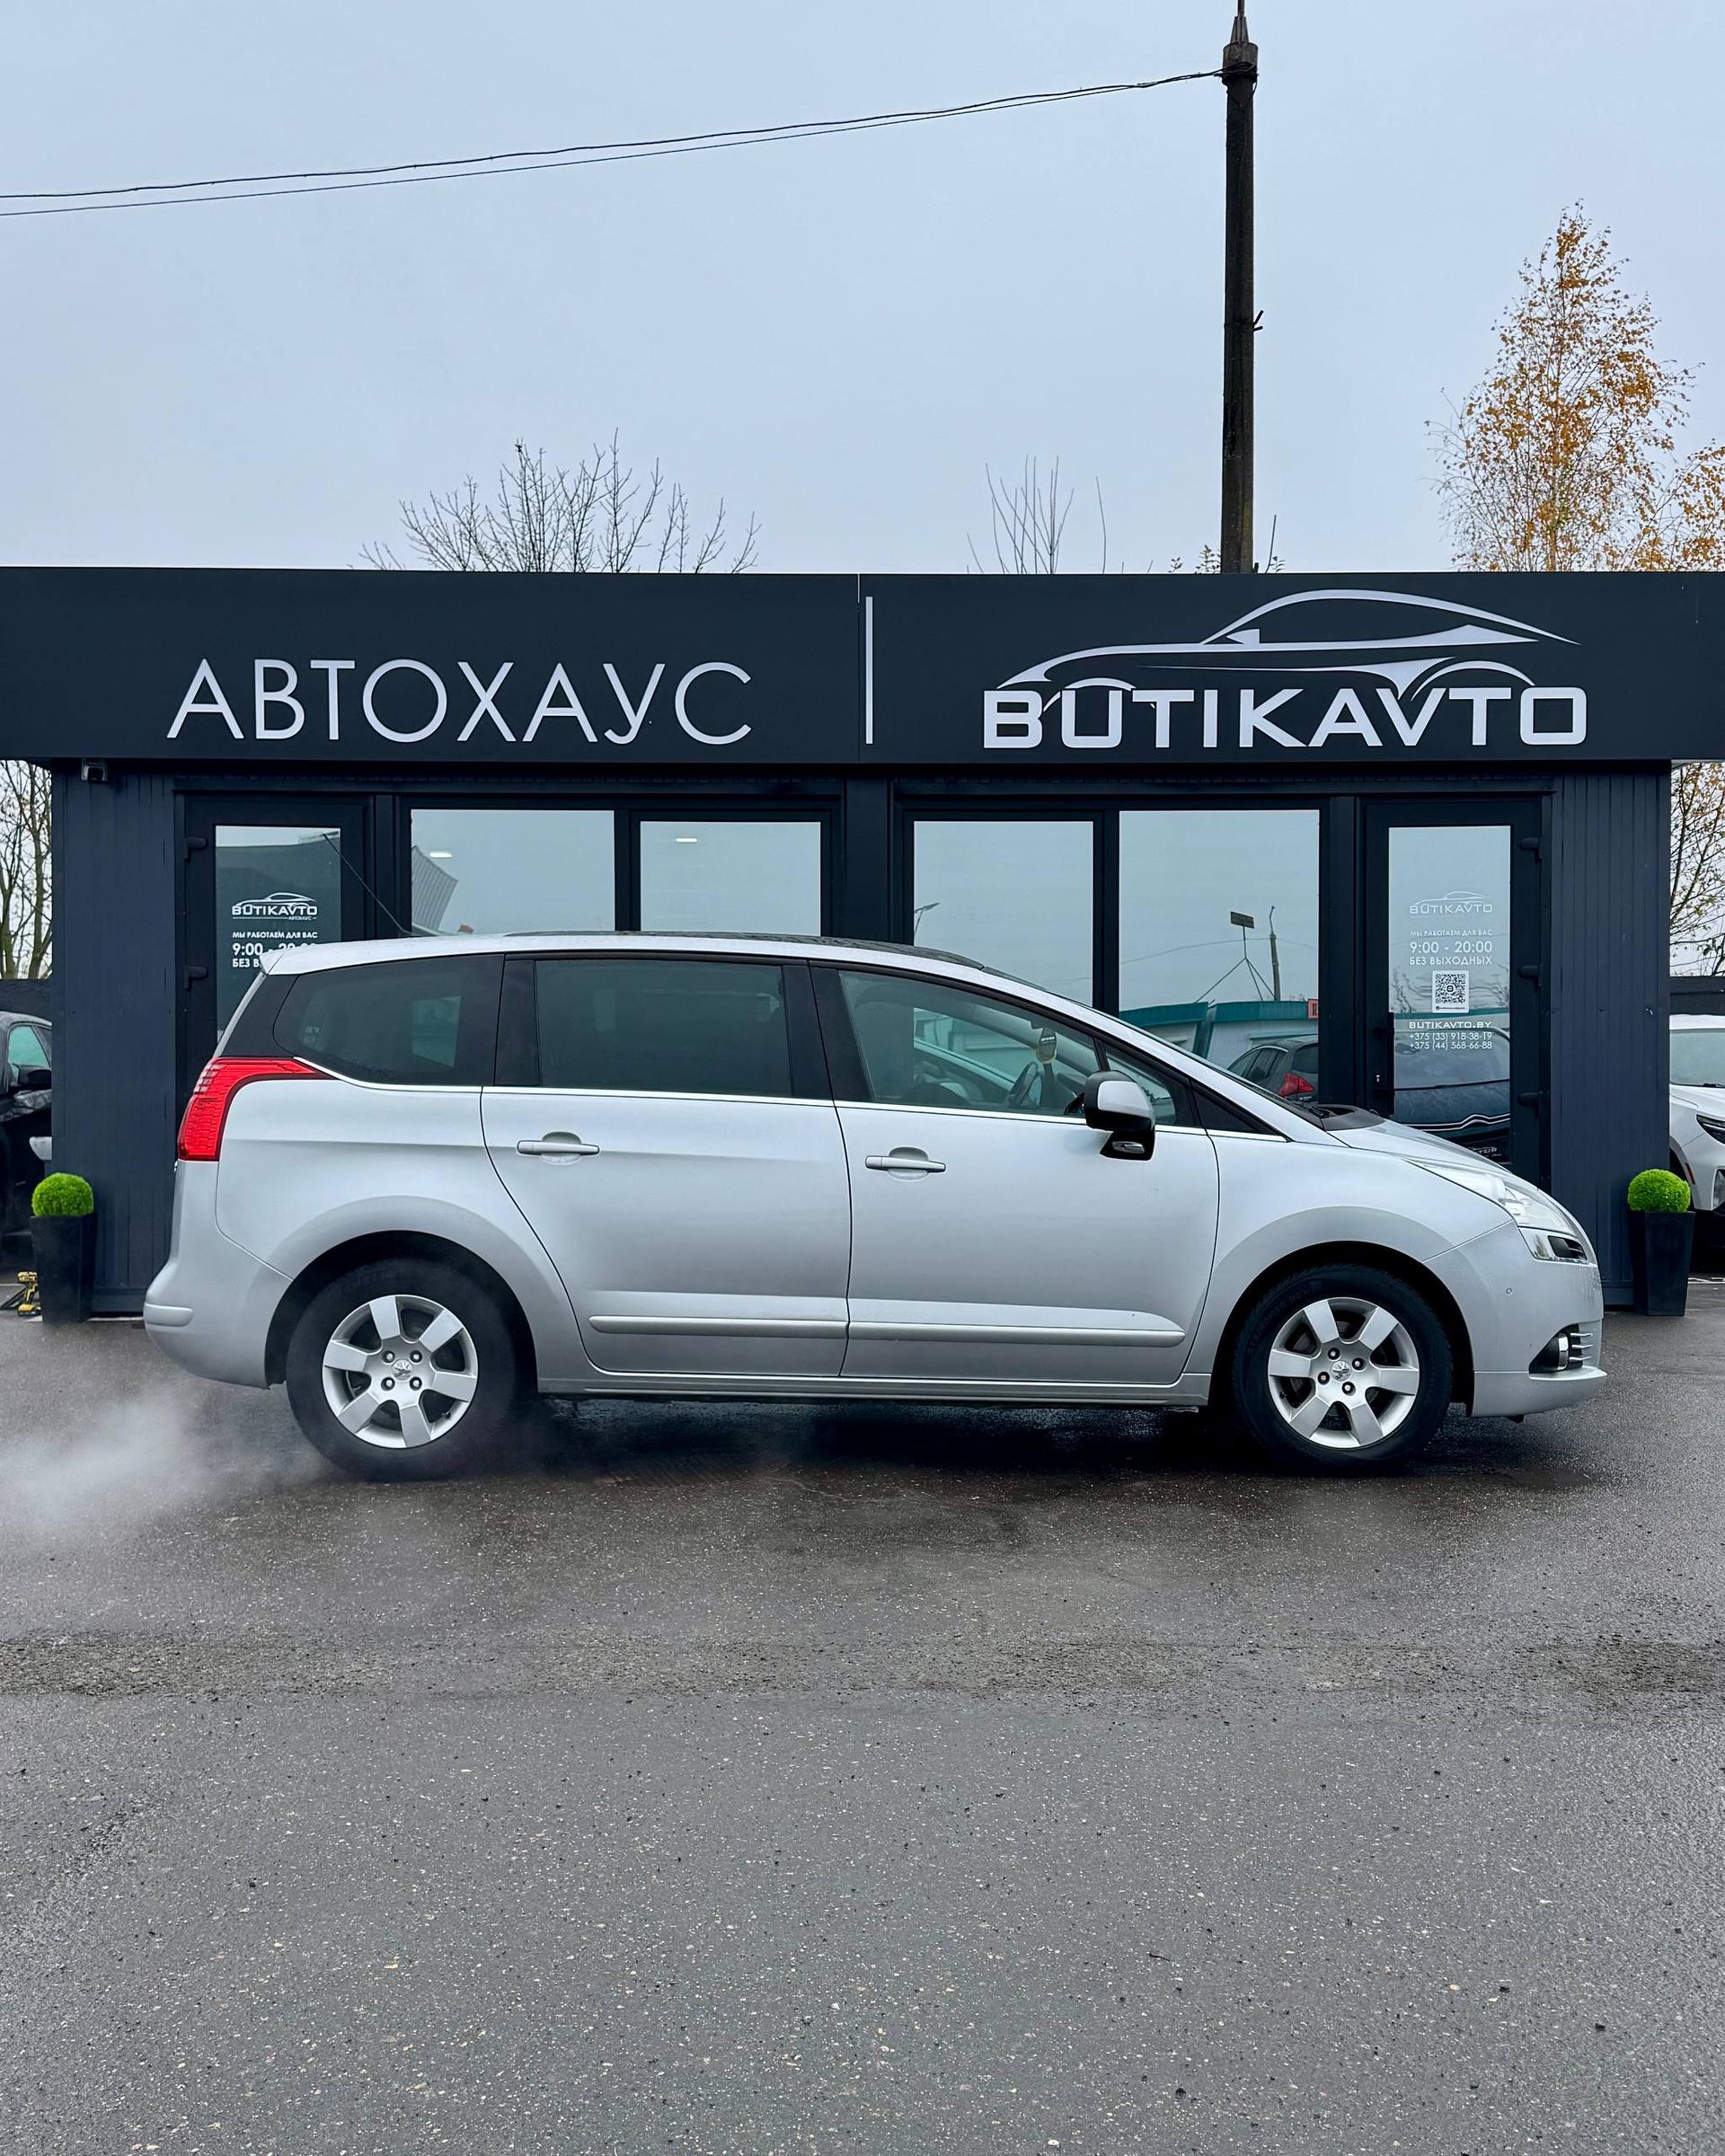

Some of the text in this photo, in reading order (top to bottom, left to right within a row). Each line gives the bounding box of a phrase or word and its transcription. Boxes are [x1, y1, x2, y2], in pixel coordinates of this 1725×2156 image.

[167, 658, 752, 746] АВТОХАУС
[983, 686, 1588, 749] BUTIKAVTO
[232, 906, 318, 915] BUTIKAVTO
[1410, 904, 1492, 914] BUTIKAVTO
[286, 932, 301, 940] ДЛЯ
[232, 942, 263, 956] 9:00
[1410, 941, 1438, 953] 9:00
[1454, 941, 1492, 953] 20:00
[232, 958, 251, 968] БЕЗ
[1410, 956, 1492, 965] БЕЗ ВЫХОДНЫХ
[1409, 1032, 1492, 1042] +375 (33) 918-38-19
[1409, 1041, 1492, 1051] +375 (44) 568-66-88
